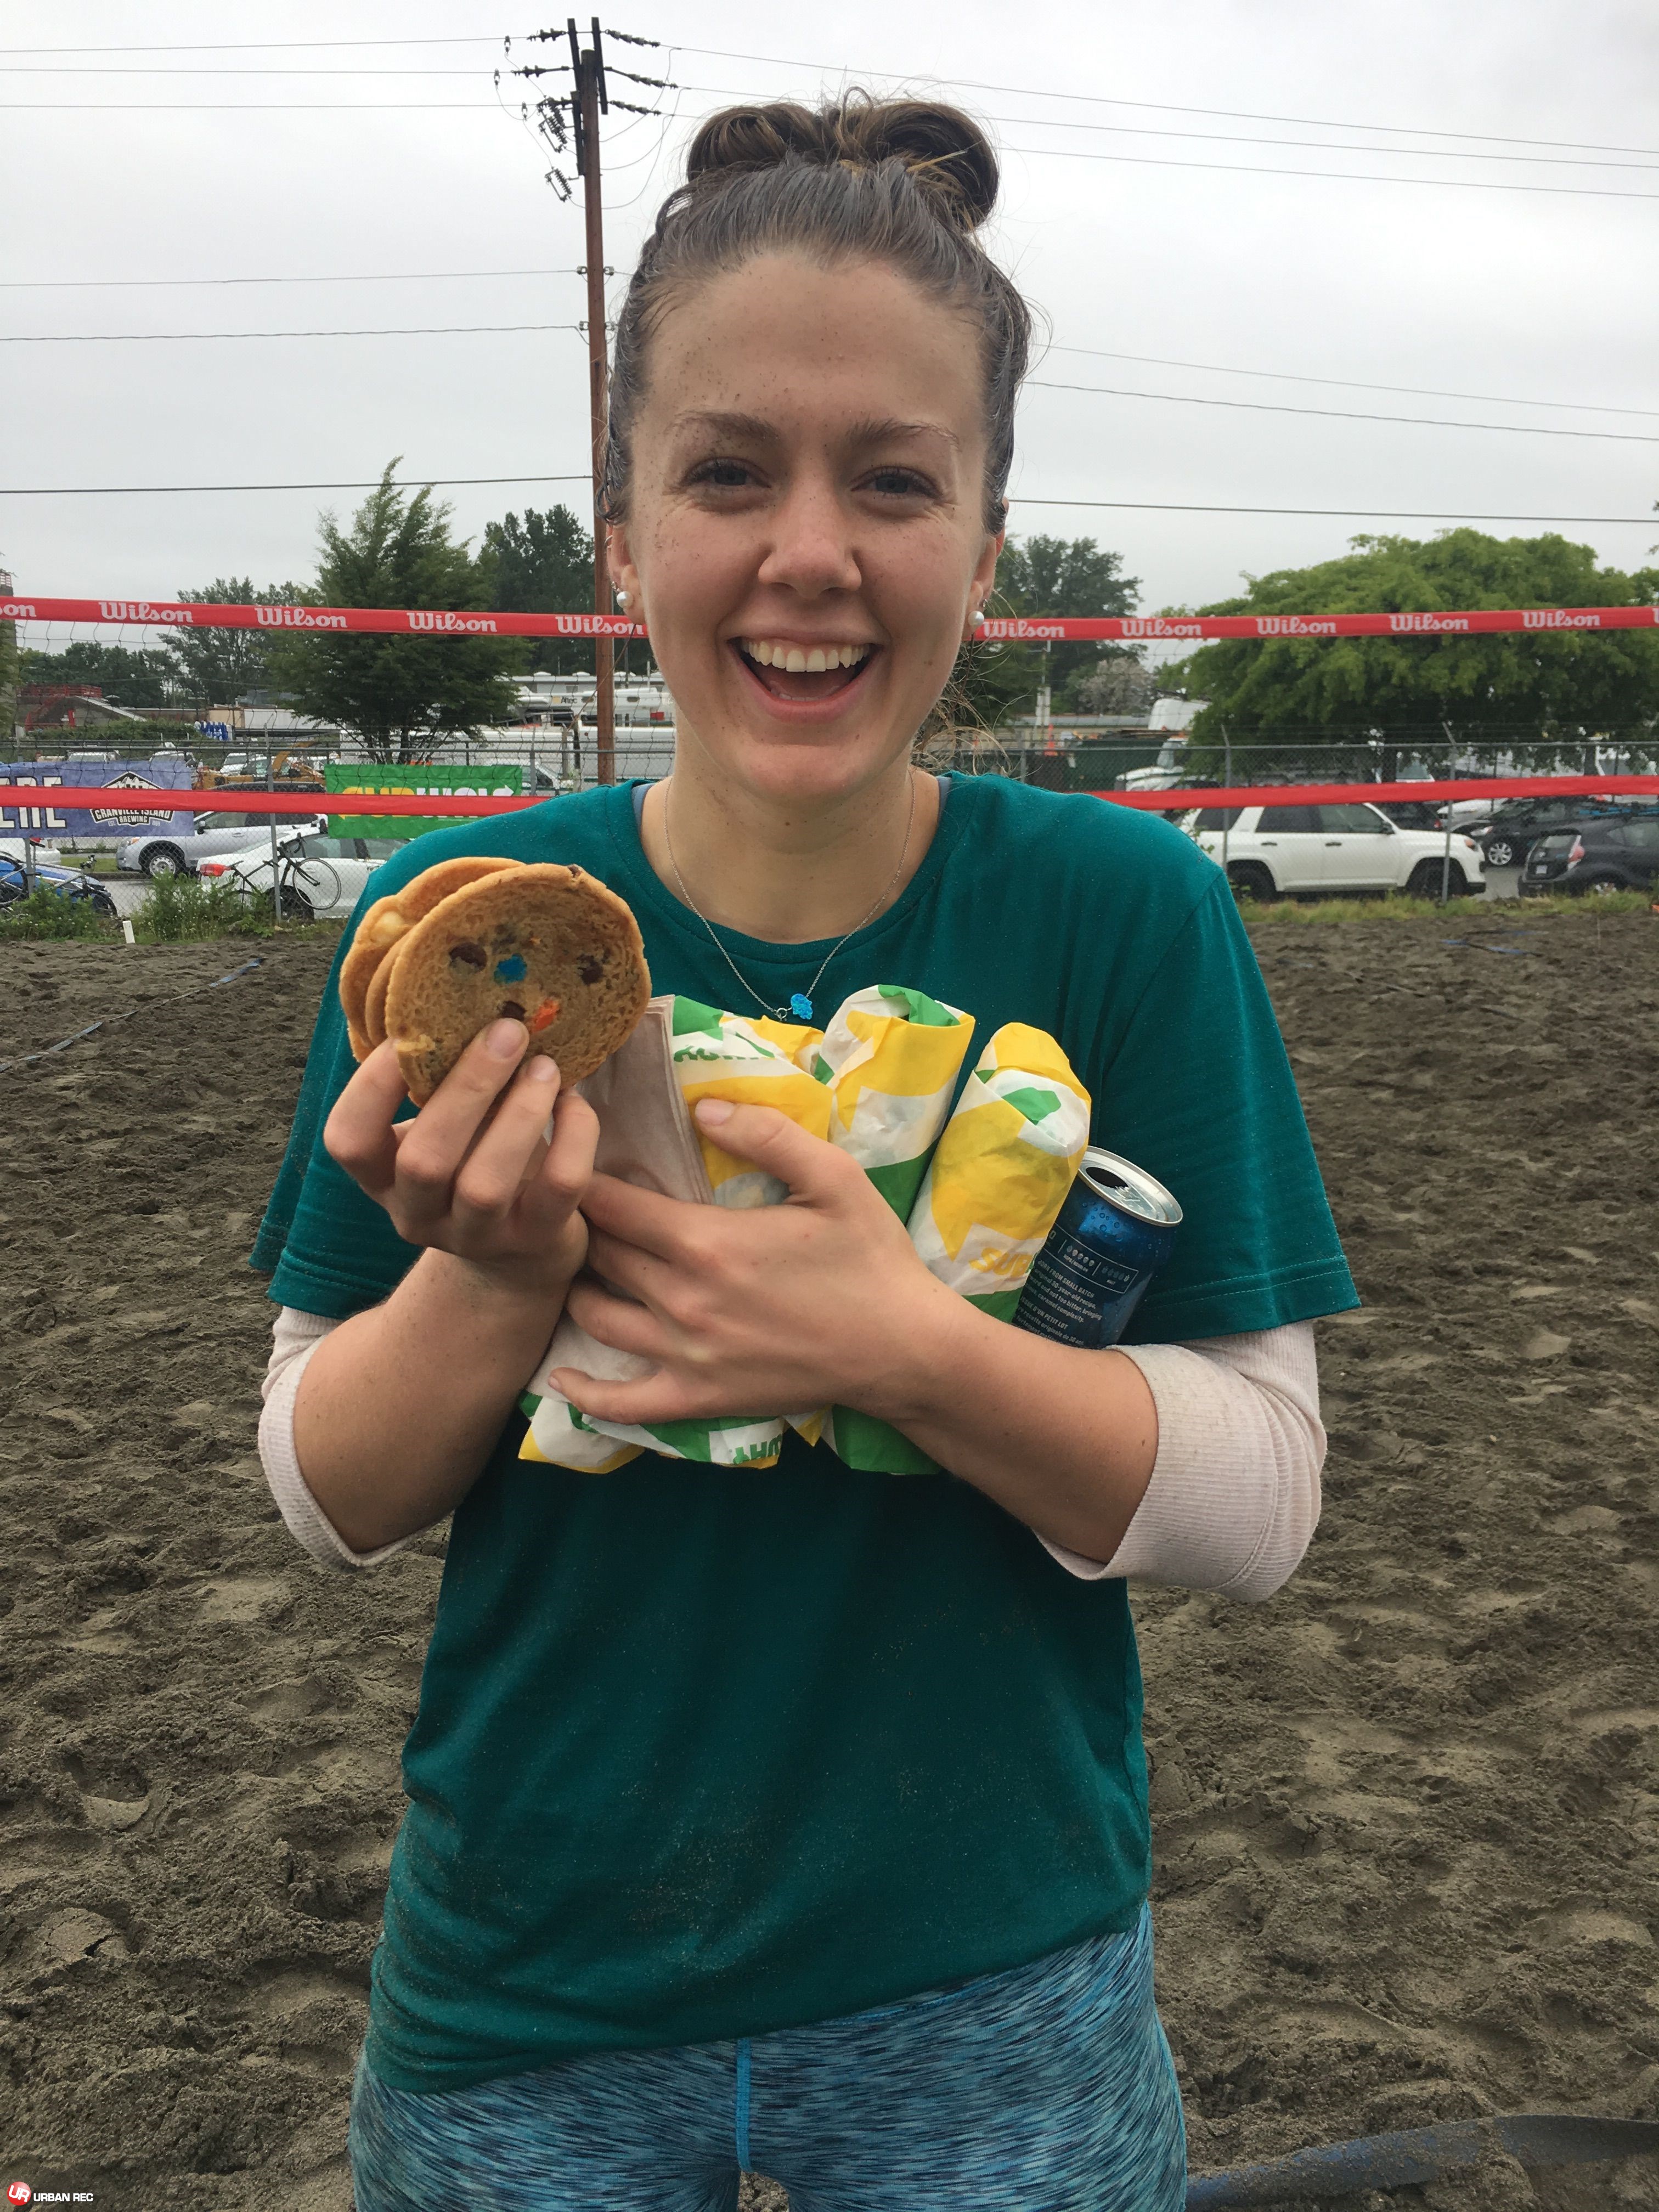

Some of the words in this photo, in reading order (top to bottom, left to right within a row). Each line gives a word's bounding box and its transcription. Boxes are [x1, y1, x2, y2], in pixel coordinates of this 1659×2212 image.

[99, 602, 193, 623] Wilson
[255, 607, 348, 628] Wilson
[1522, 610, 1600, 629] Wilson
[407, 612, 497, 633] Wilson
[555, 616, 644, 636] Wilson
[983, 620, 1065, 639] Wilson
[1120, 619, 1202, 637] Wilson
[1256, 617, 1336, 635] Wilson
[1389, 614, 1469, 631] Wilson
[119, 815, 148, 823] BREWING
[1040, 1284, 1050, 1293] and
[1049, 1268, 1063, 1280] FROM
[1062, 1277, 1079, 1290] SMALL
[1077, 1287, 1094, 1298] BATCH
[1037, 1294, 1057, 1308] caramel
[1044, 1314, 1058, 1324] PETIT
